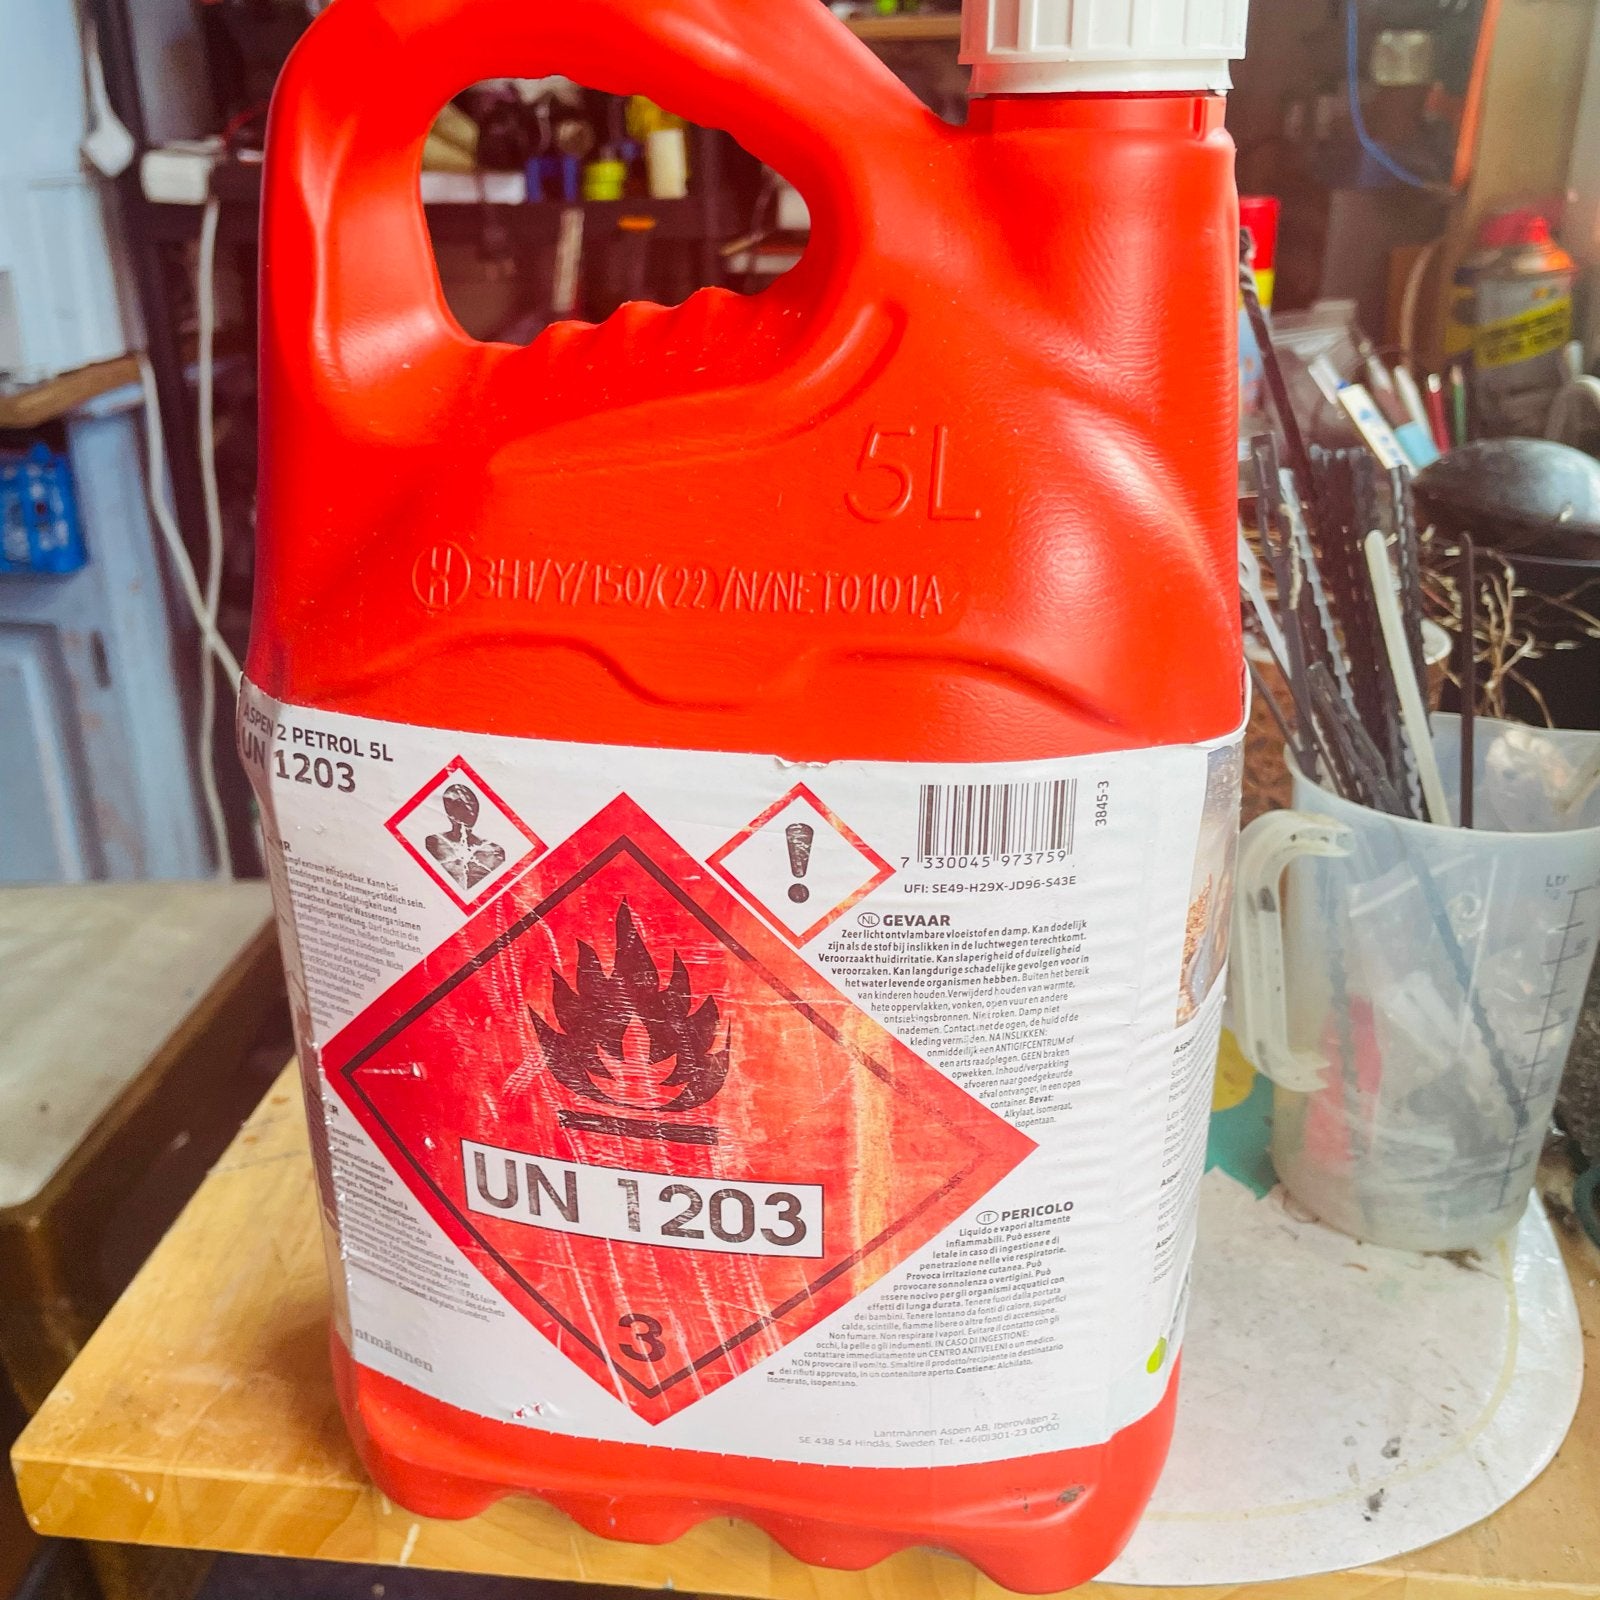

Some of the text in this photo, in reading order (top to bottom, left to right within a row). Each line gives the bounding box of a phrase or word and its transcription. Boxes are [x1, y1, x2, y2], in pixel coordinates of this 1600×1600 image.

[844, 423, 981, 523] 5L
[243, 702, 393, 762] ASPEN 2 PETROL 5L
[242, 726, 356, 793] UN 1203
[1094, 780, 1109, 827] 3845-3
[900, 850, 1066, 869] 7 330045 973759
[904, 876, 1076, 894] UFI: SE49-H29X-JD96-S43E
[841, 929, 862, 938] Zeer
[863, 929, 884, 938] licht
[885, 930, 944, 939] ontvlambare
[946, 928, 988, 938] vloeistof
[1001, 927, 1030, 936] damp.
[1032, 924, 1048, 933] Kan
[1050, 920, 1086, 931] dodelijk
[862, 915, 951, 926] NL GEVAAR
[818, 944, 1080, 963] Veroorzaakt huidirritatie. Kan slaperigheid of duizeligheid
[828, 932, 1086, 953] zijn als de stof bij inslikken in de luchtwegen terechtkomt.
[831, 954, 1088, 976] veroorzaken. Kan langdurige schadelijke gevolgen voor in
[845, 966, 1089, 988] het water levende organismen hebben. Buiten het bereik
[874, 990, 911, 999] kinderen
[947, 986, 992, 998] Verwijderd
[994, 985, 1026, 995] houden
[1028, 984, 1041, 992] van
[1043, 980, 1075, 990] warmte,
[871, 1003, 889, 1011] hete
[890, 1001, 950, 1013] oppervlakken,
[952, 1000, 984, 1009] vonken,
[1040, 993, 1068, 1002] andere
[474, 1151, 807, 1247] UN 1203
[983, 1201, 1074, 1222] IT PERICOLO
[959, 1226, 992, 1238] Liquido
[999, 1220, 1026, 1233] vapori
[1028, 1215, 1070, 1227] altamente
[932, 1249, 957, 1259] letale
[959, 1248, 967, 1257] in
[968, 1248, 987, 1256] caso
[989, 1245, 997, 1254] di
[999, 1240, 1044, 1253] ingestione
[1051, 1235, 1059, 1244] di
[946, 1234, 1004, 1248] infiammabili.
[1006, 1231, 1022, 1241] Può
[906, 1258, 1041, 1281] Provoca irritazione cutanea. Può
[919, 1246, 1066, 1272] penetrazione nelle vie respiratorie.
[893, 1282, 936, 1293] provocare
[937, 1278, 987, 1288] sonnolenza
[995, 1270, 1033, 1283] vertigini.
[1035, 1266, 1050, 1276] Può
[618, 1313, 667, 1362] 3
[355, 1329, 434, 1373] ntmännen
[874, 1429, 936, 1438] Lantmännen
[941, 1427, 971, 1436] Aspen
[896, 1439, 935, 1448] Sweden
